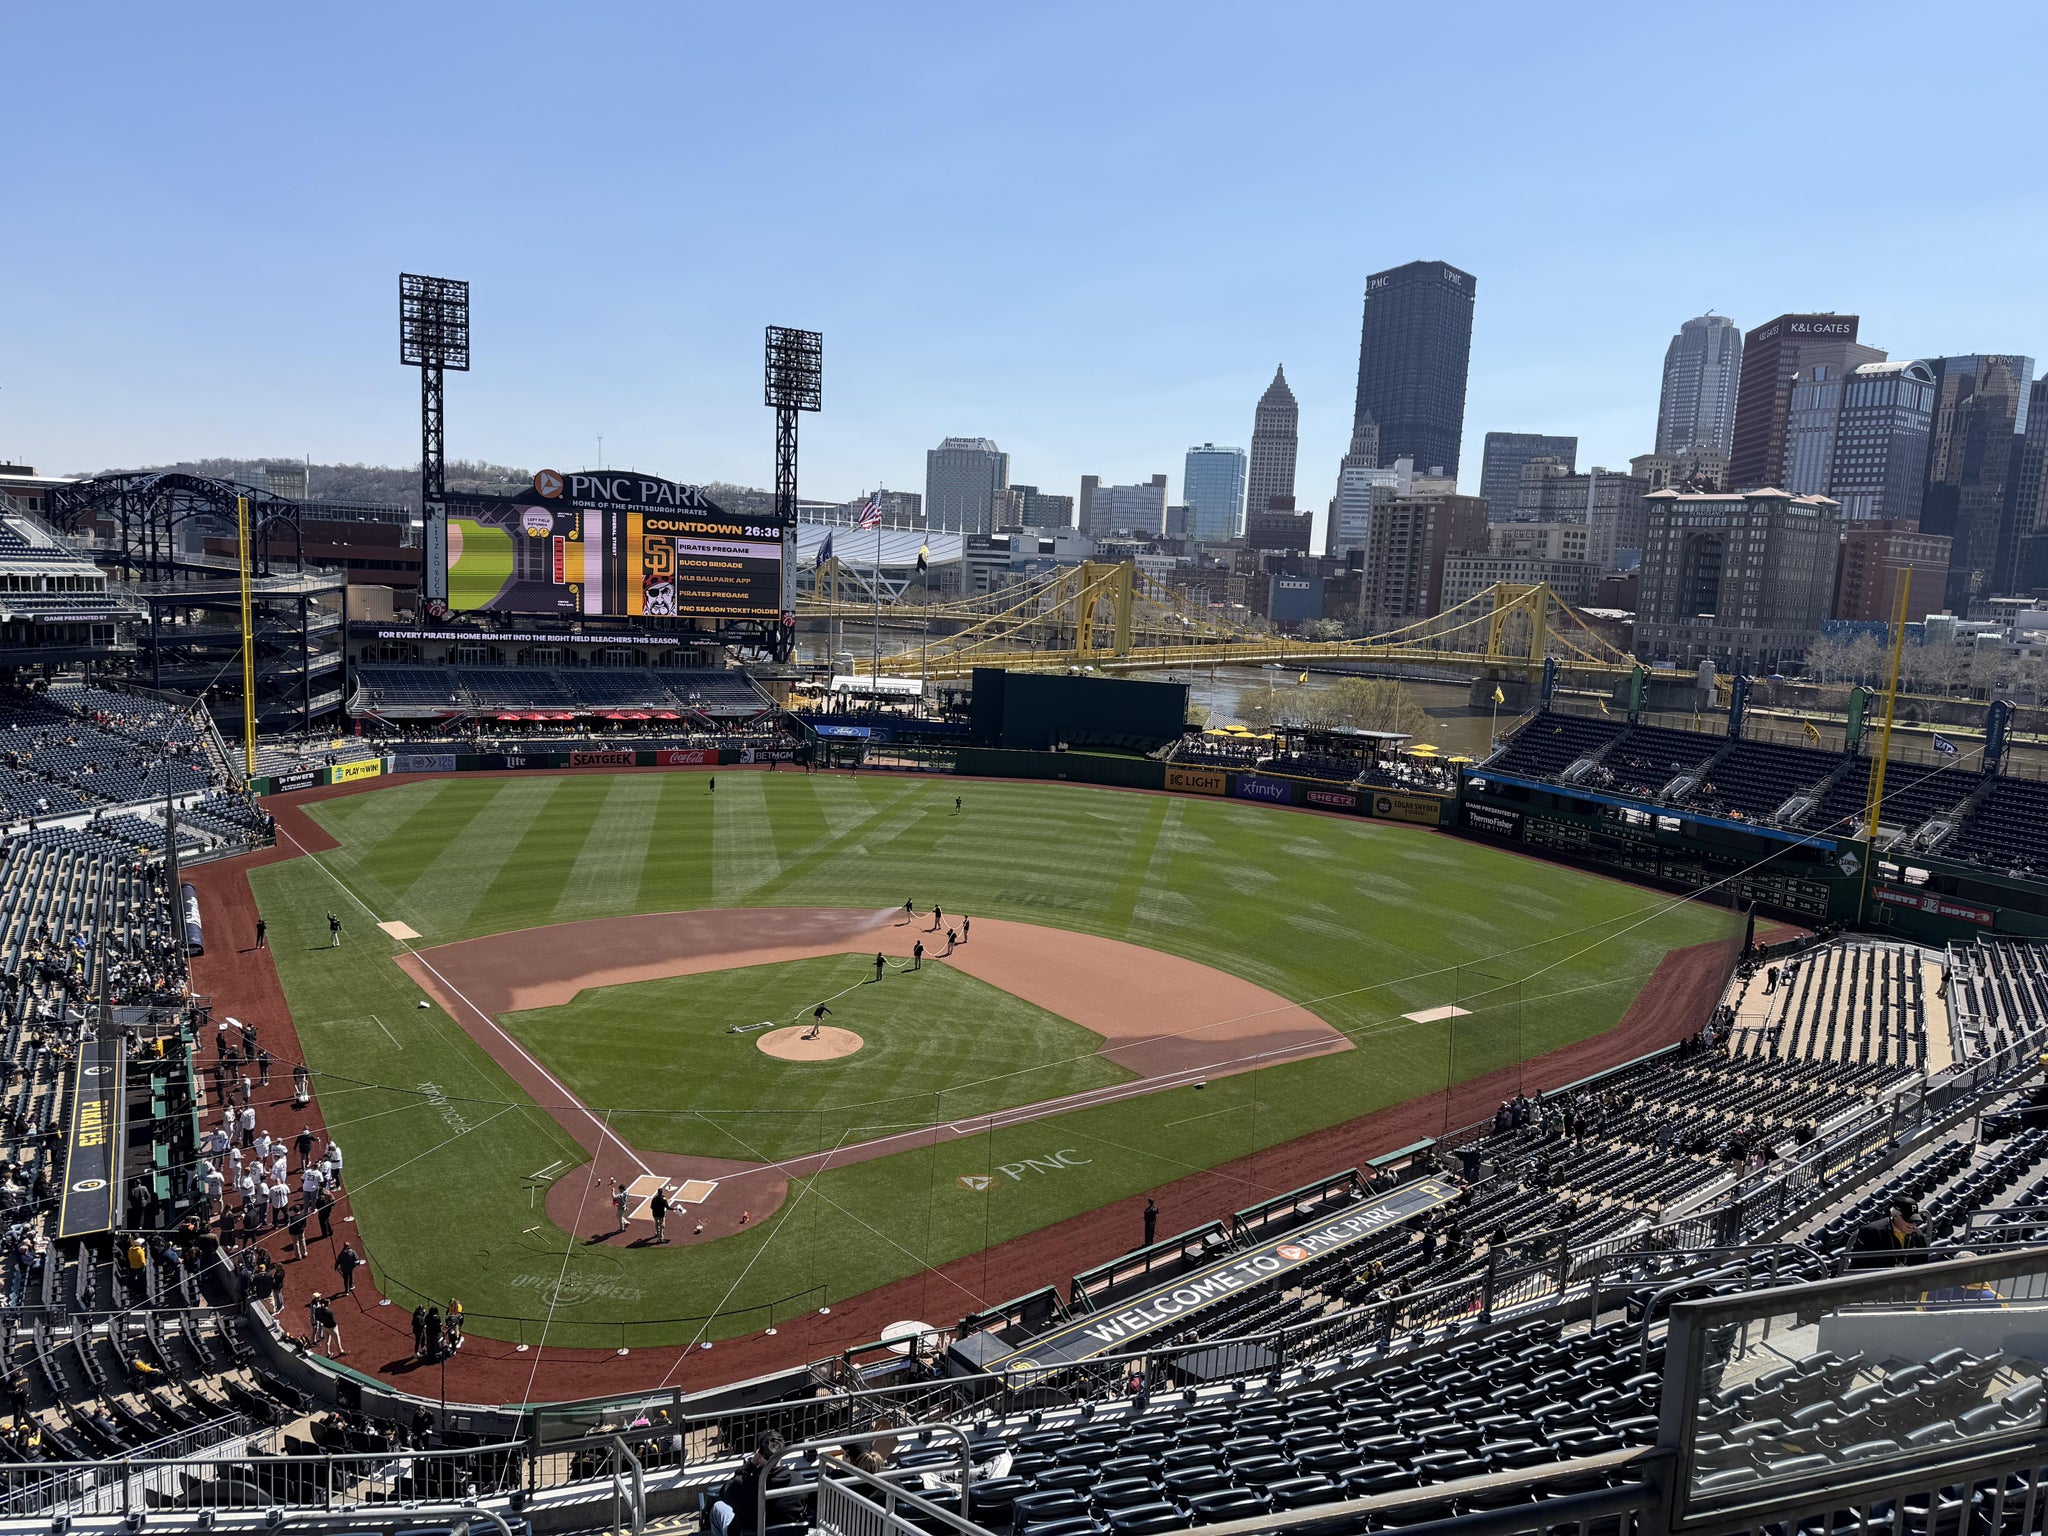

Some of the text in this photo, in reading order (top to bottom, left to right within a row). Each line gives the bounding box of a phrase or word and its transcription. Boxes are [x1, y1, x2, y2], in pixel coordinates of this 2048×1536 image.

[1443, 268, 1462, 286] UPMC
[1766, 324, 1780, 339] GATES
[1791, 323, 1850, 334] K&L GATES
[569, 475, 709, 508] PNC PARK
[572, 500, 708, 516] HOME OF THE PITTSBURGH PIRATES
[646, 519, 780, 538] COUNTDOWN 26:36
[433, 524, 441, 550] LETZ
[679, 544, 750, 554] PIRATES PREGAME
[433, 553, 440, 567] GO
[709, 561, 743, 569] BRIGADE
[679, 590, 749, 599] PIRATES PREGAME
[695, 605, 726, 613] SEASON
[751, 607, 779, 615] HOLDER
[378, 631, 395, 639] FOR
[396, 631, 422, 639] EVERY
[422, 632, 456, 640] PIRATES
[532, 634, 547, 642] THE
[590, 636, 632, 644] BLEACHERS
[649, 637, 680, 646] SEASON,
[506, 757, 526, 768] Lite
[573, 753, 632, 766] SEATGEEK
[669, 751, 705, 764] Coca-Cola
[756, 751, 794, 761] BETMGM
[345, 767, 359, 776] PLAY
[365, 763, 379, 773] WIN!
[1170, 774, 1221, 789] IC LIGHT
[1243, 781, 1284, 799] xfinity
[1309, 792, 1354, 805] SHEETZ
[1394, 801, 1414, 810] EDGAR
[1414, 803, 1438, 813] SNYDER
[1465, 802, 1482, 811] GAME
[1481, 805, 1511, 817] PRESENTED
[1469, 820, 1512, 836] SCIENTIFIC
[1878, 891, 1918, 905] SHEETZ
[78, 1099, 109, 1147] PIRATES
[437, 1105, 474, 1134] mobile
[993, 1148, 1093, 1182] PNC
[81, 1180, 99, 1189] P
[306, 1174, 315, 1182] 23
[1420, 1184, 1446, 1200] P
[1911, 1204, 1917, 1213] P
[1083, 1203, 1402, 1344] WELCOME TO PNC PARK
